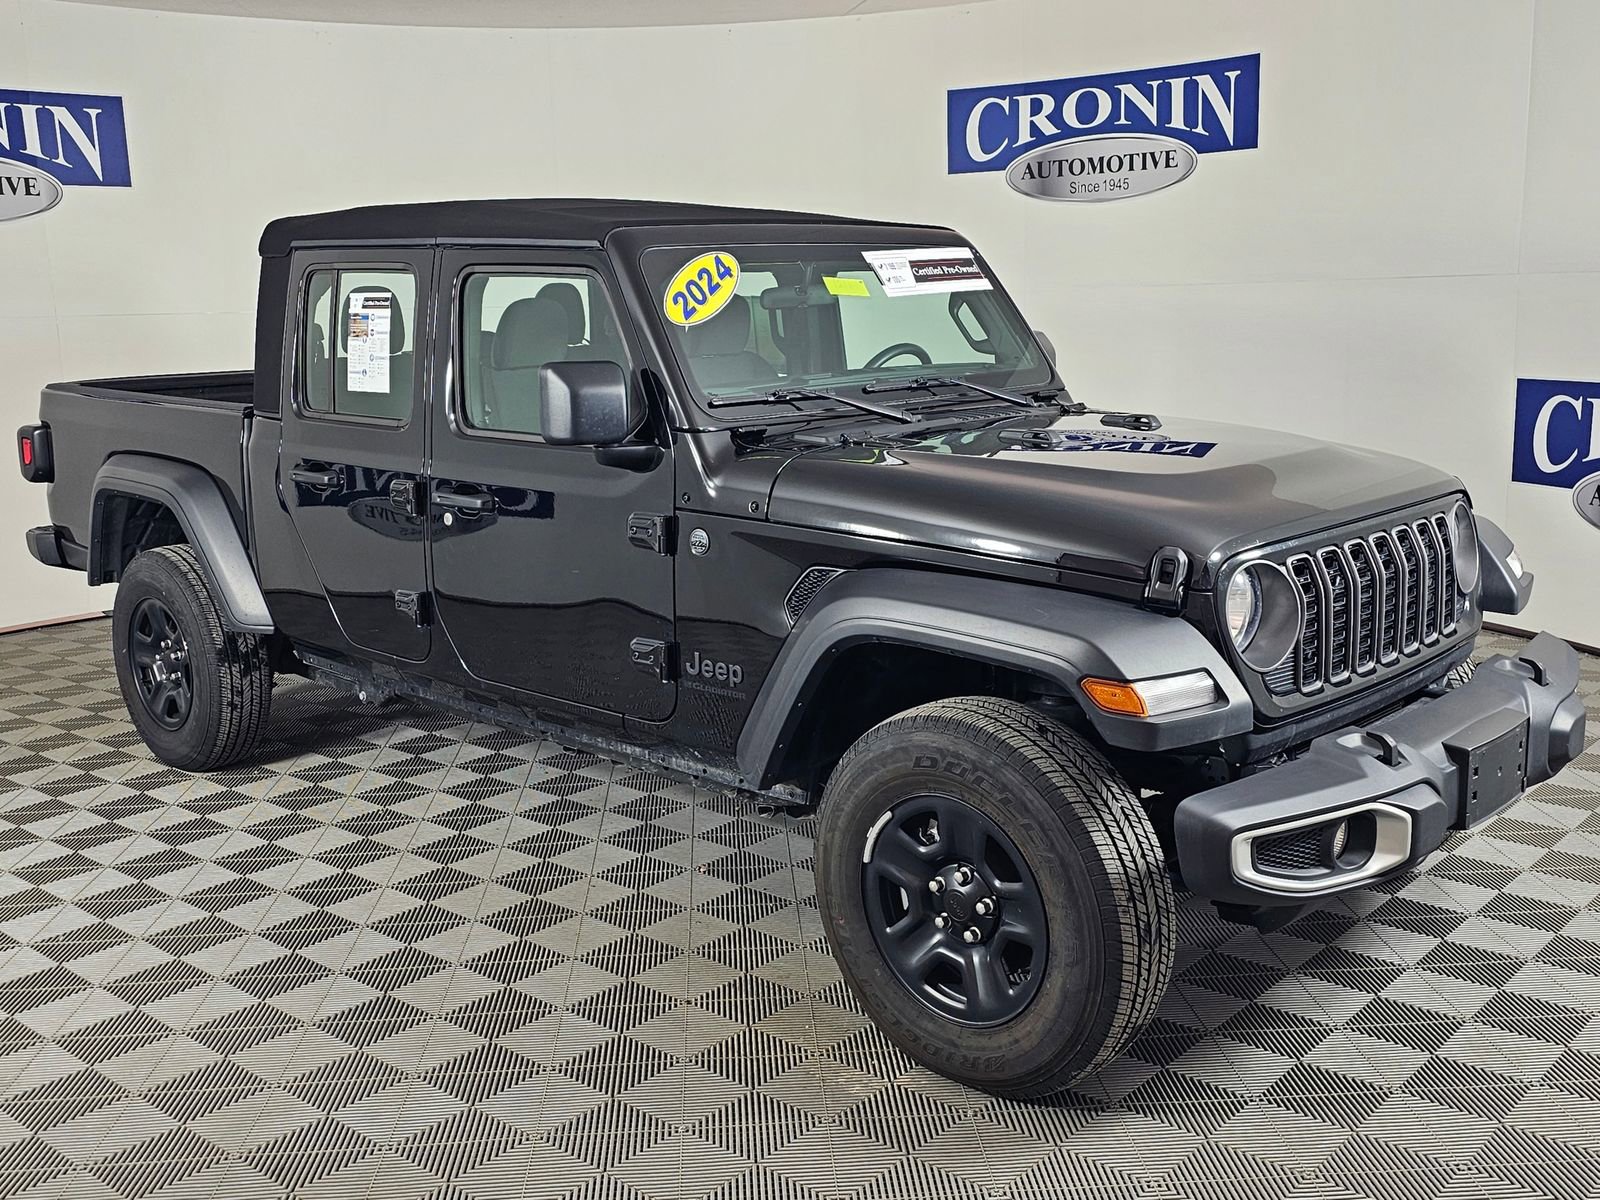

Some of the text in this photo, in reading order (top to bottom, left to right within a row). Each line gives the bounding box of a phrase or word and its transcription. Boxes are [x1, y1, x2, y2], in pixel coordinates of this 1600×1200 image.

[965, 70, 1241, 163] CRONIN
[0, 102, 103, 182] IN
[1021, 149, 1179, 181] AUTOMOTIVE
[1069, 177, 1130, 194] Since 1945
[672, 254, 734, 321] 2024
[912, 265, 943, 276] Certified
[944, 264, 979, 275] Pre-Owned
[685, 651, 743, 688] Jeep
